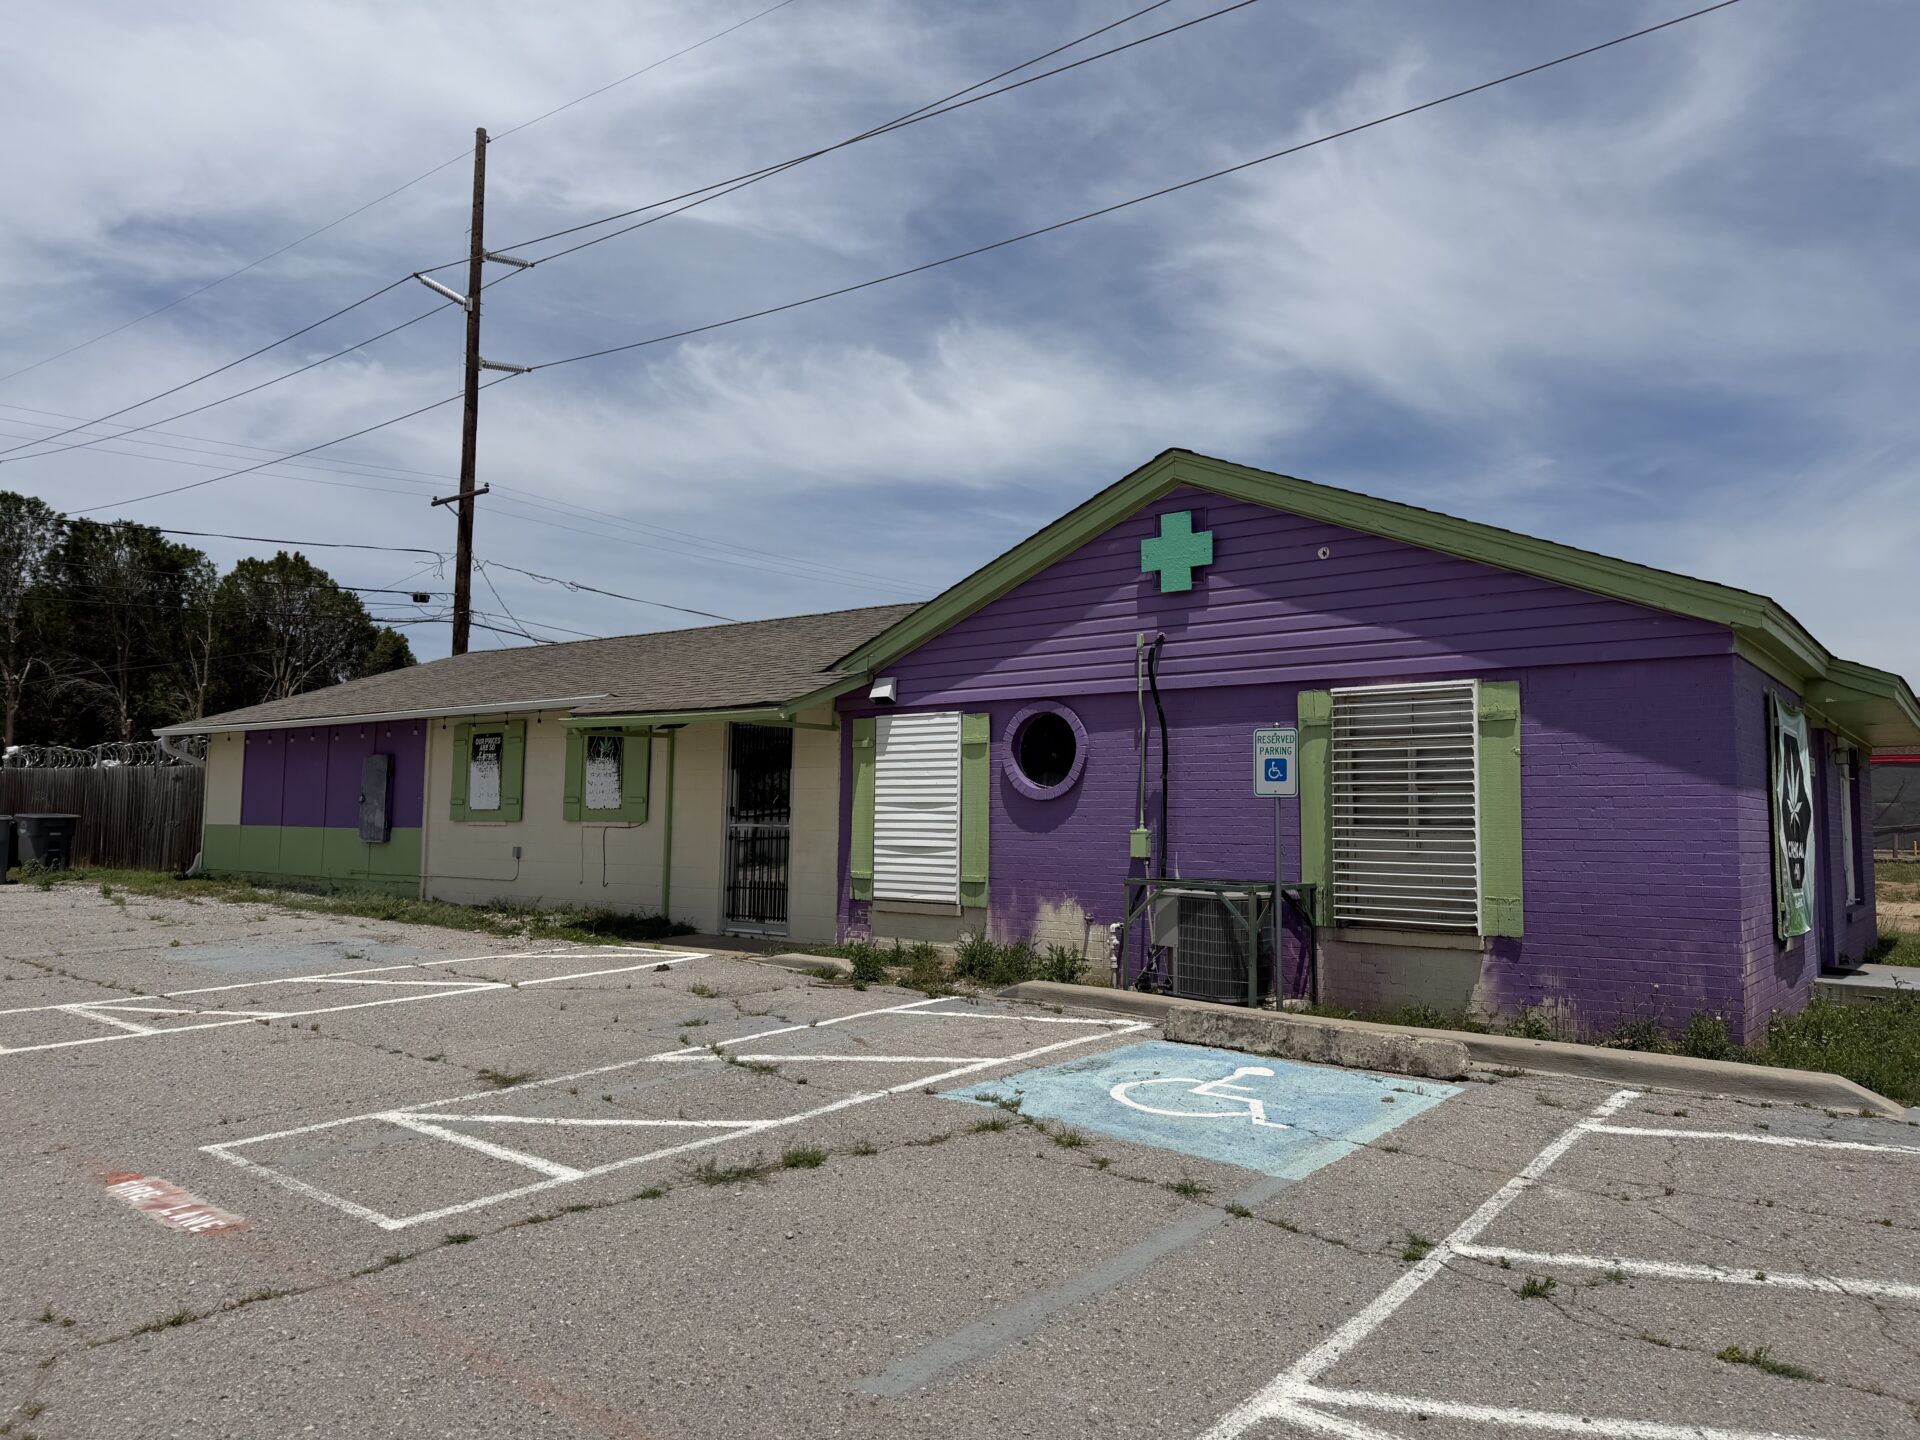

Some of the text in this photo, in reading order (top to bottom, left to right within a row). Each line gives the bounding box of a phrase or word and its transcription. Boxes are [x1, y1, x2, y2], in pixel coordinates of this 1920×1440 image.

[475, 737, 501, 746] OUR PRICES
[1257, 734, 1295, 744] RESERVED
[1259, 746, 1292, 756] PARKING
[104, 1180, 226, 1232] FIRE LANE
